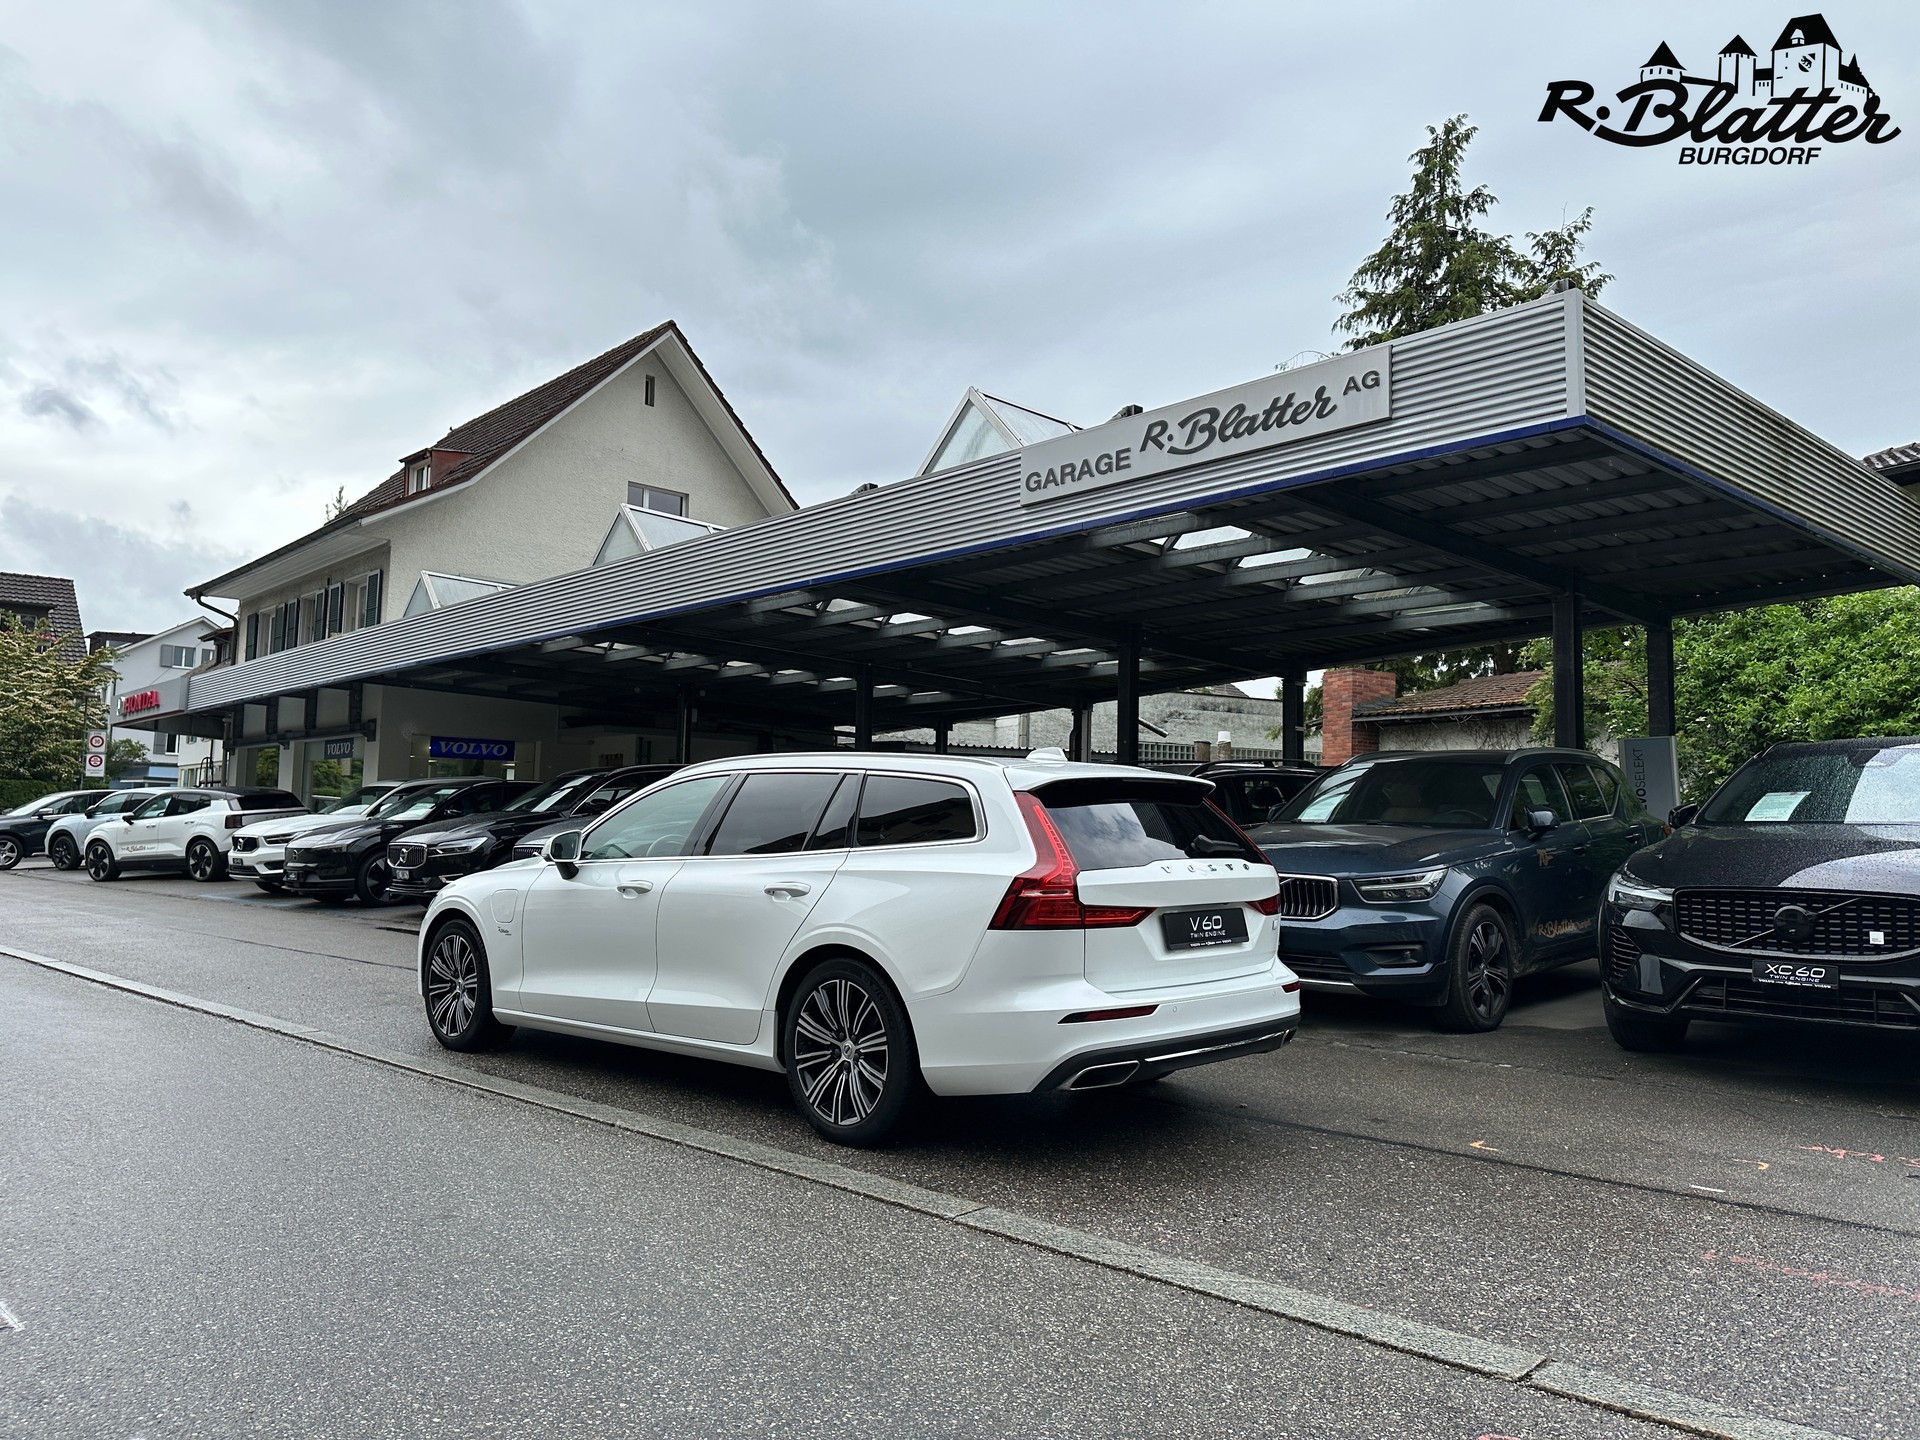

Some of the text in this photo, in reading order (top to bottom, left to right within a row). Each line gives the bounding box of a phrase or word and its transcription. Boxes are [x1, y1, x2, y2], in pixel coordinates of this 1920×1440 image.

[1025, 446, 1132, 493] GARAGE
[1166, 385, 1338, 455] Blatter
[1342, 369, 1381, 396] AG
[123, 690, 160, 714] HONDA
[327, 742, 351, 756] VOLVO
[439, 741, 508, 756] VOLVO
[1789, 975, 1821, 983] ENGINE
